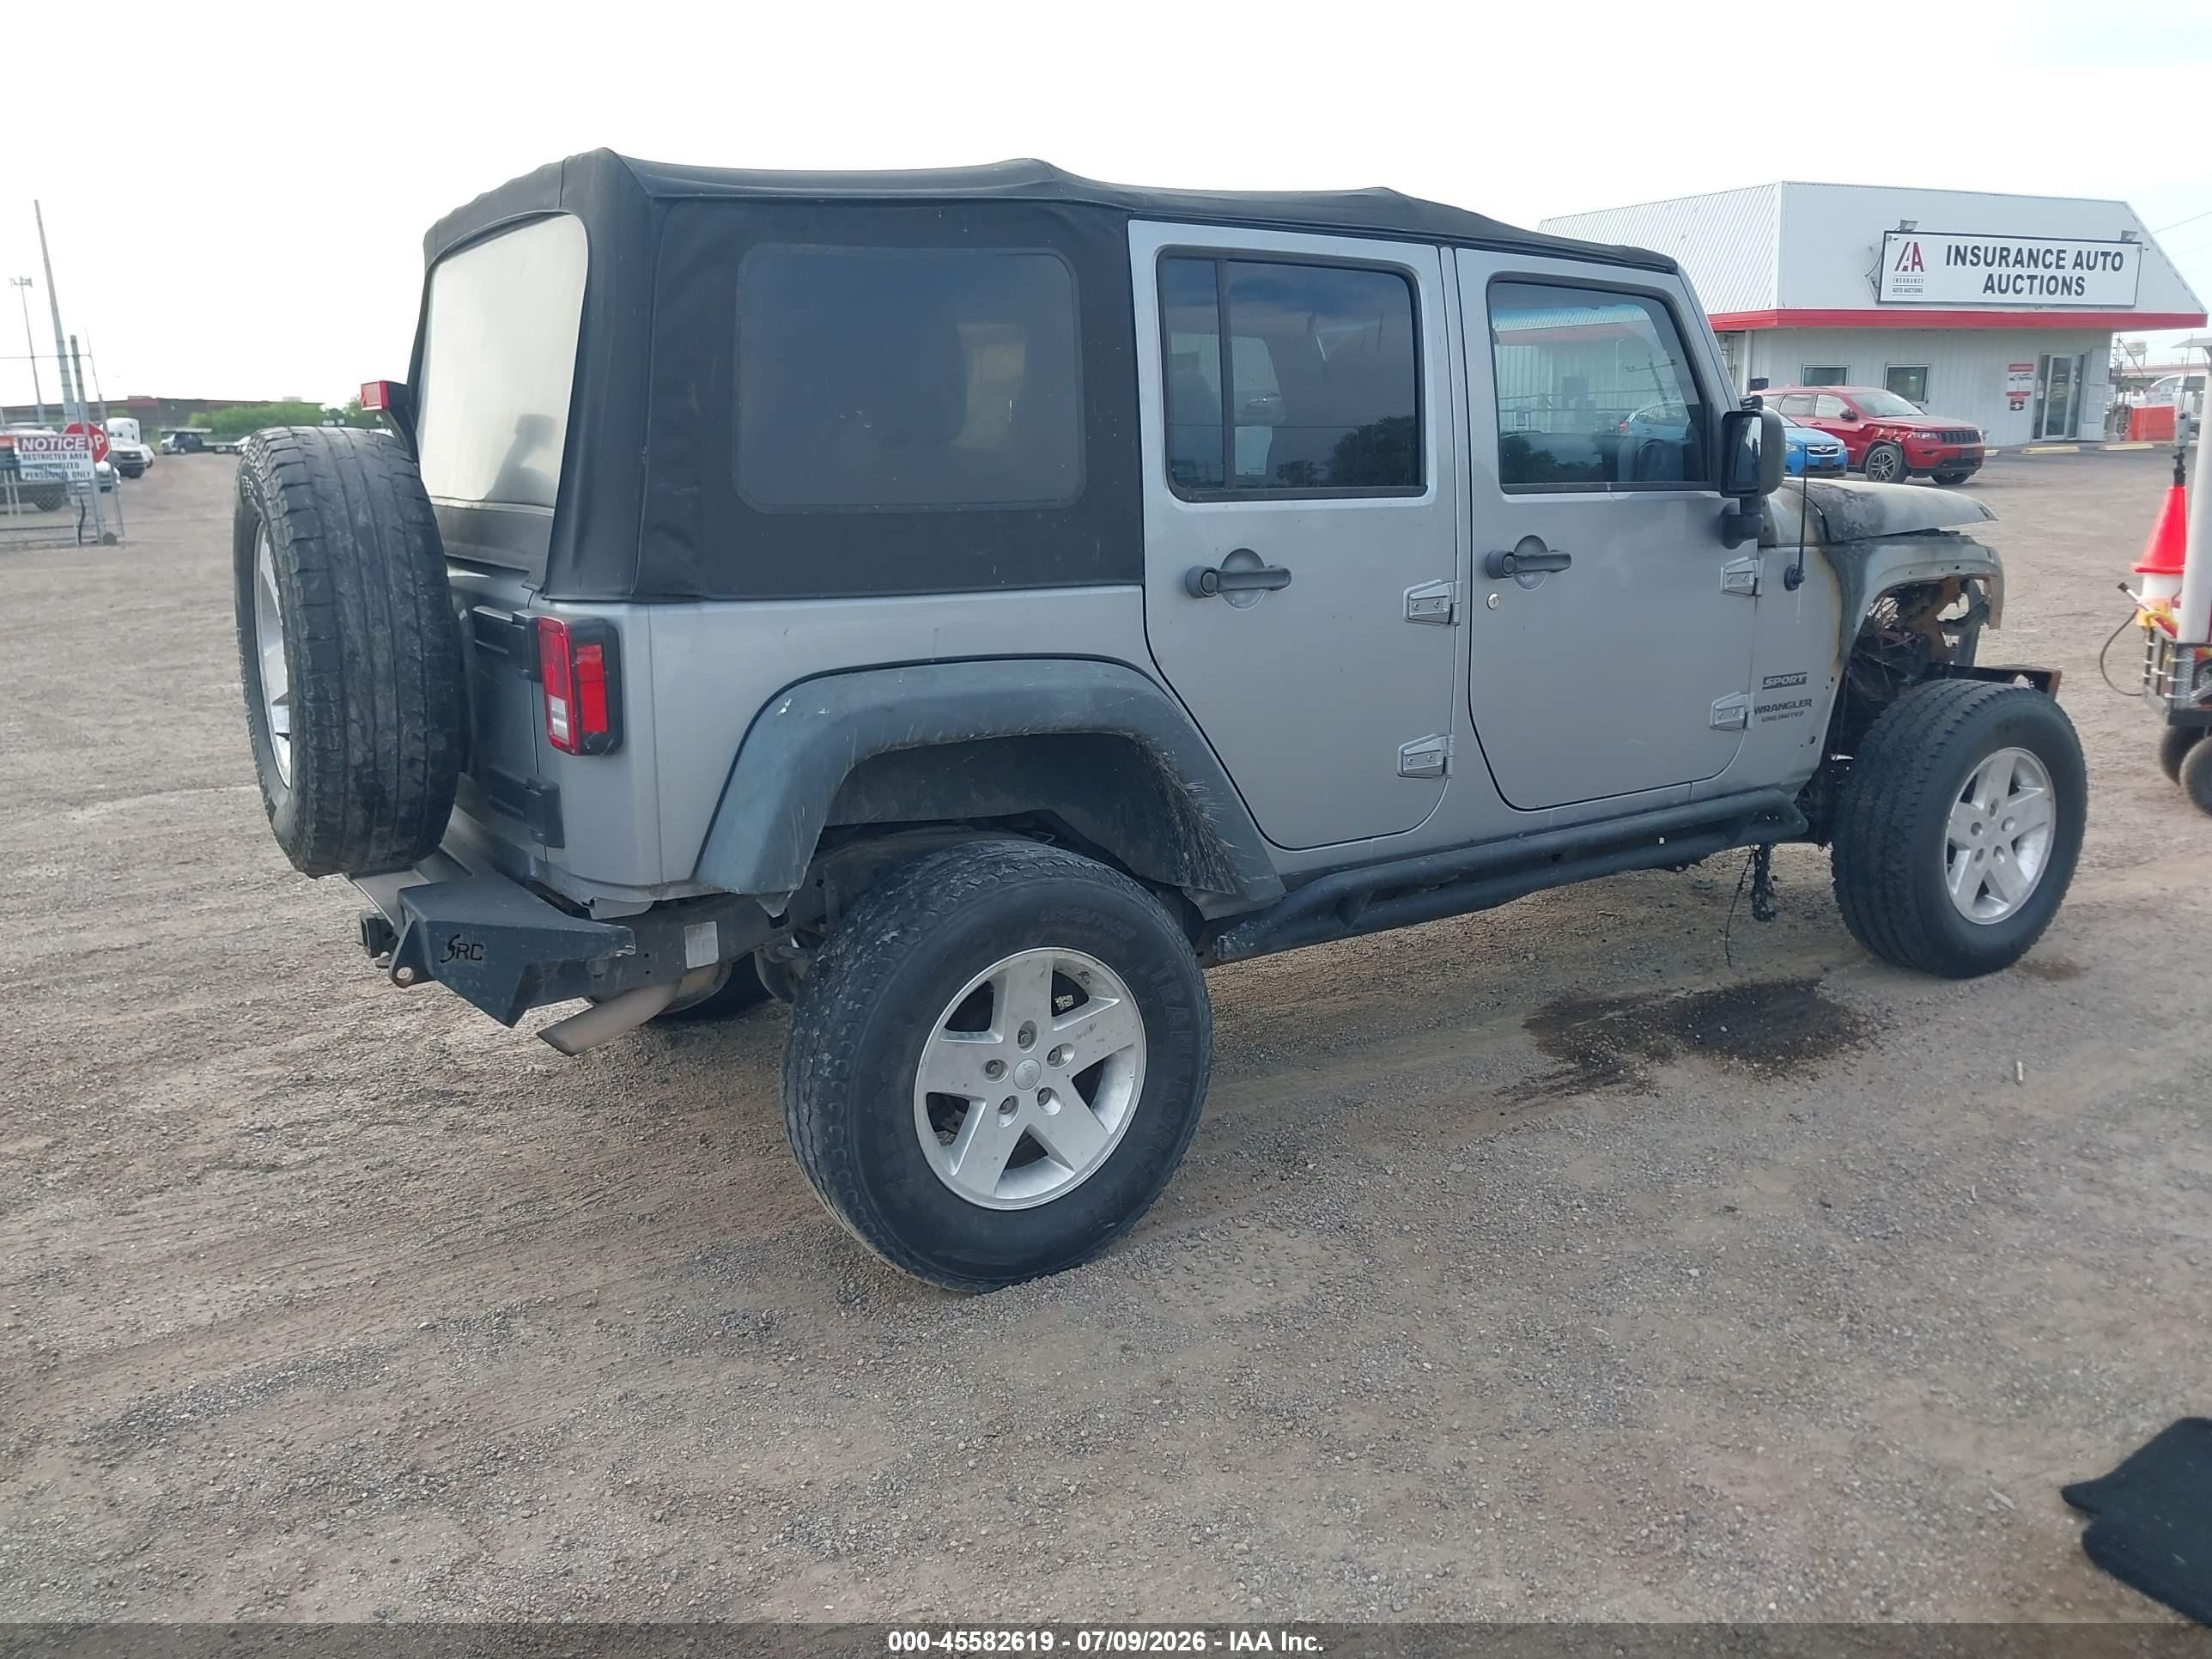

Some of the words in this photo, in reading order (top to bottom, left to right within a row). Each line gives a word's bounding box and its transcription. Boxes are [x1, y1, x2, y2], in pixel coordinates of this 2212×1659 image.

[1946, 244, 2068, 270] INSURANCE
[2072, 250, 2124, 272] AUTO
[1983, 273, 2085, 296] AUCTIONS
[21, 438, 86, 451] NOTICE
[1765, 674, 1804, 687] SPORT
[1754, 699, 1812, 714] WRANGLER
[1762, 711, 1804, 722] UNLIMITED
[439, 933, 484, 964] SRC
